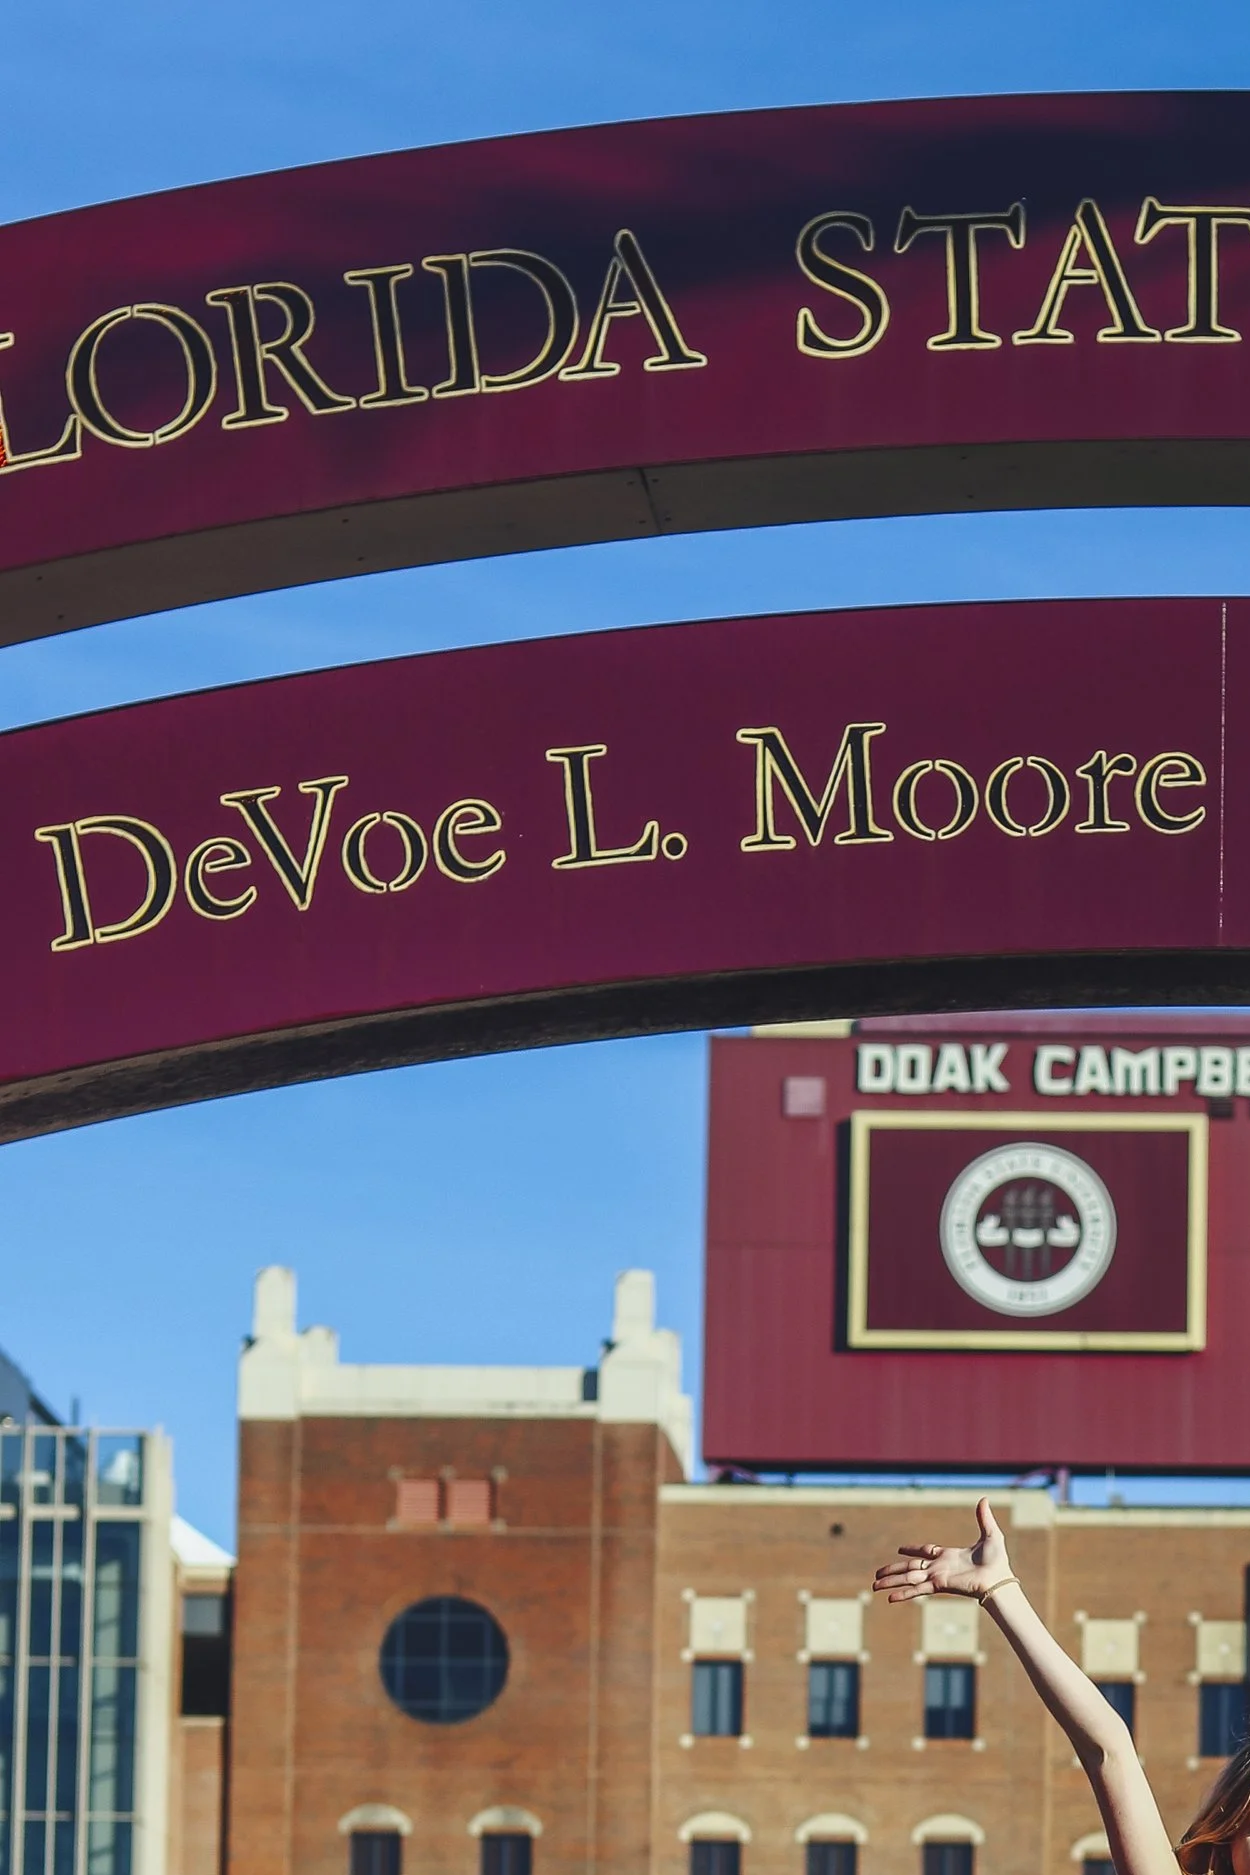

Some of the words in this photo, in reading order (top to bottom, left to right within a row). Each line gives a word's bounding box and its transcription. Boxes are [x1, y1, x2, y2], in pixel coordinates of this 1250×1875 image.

[34, 776, 508, 952] DeVoe
[545, 744, 689, 868] L.
[737, 722, 1207, 851] Moore
[857, 1042, 1010, 1094] DOAK
